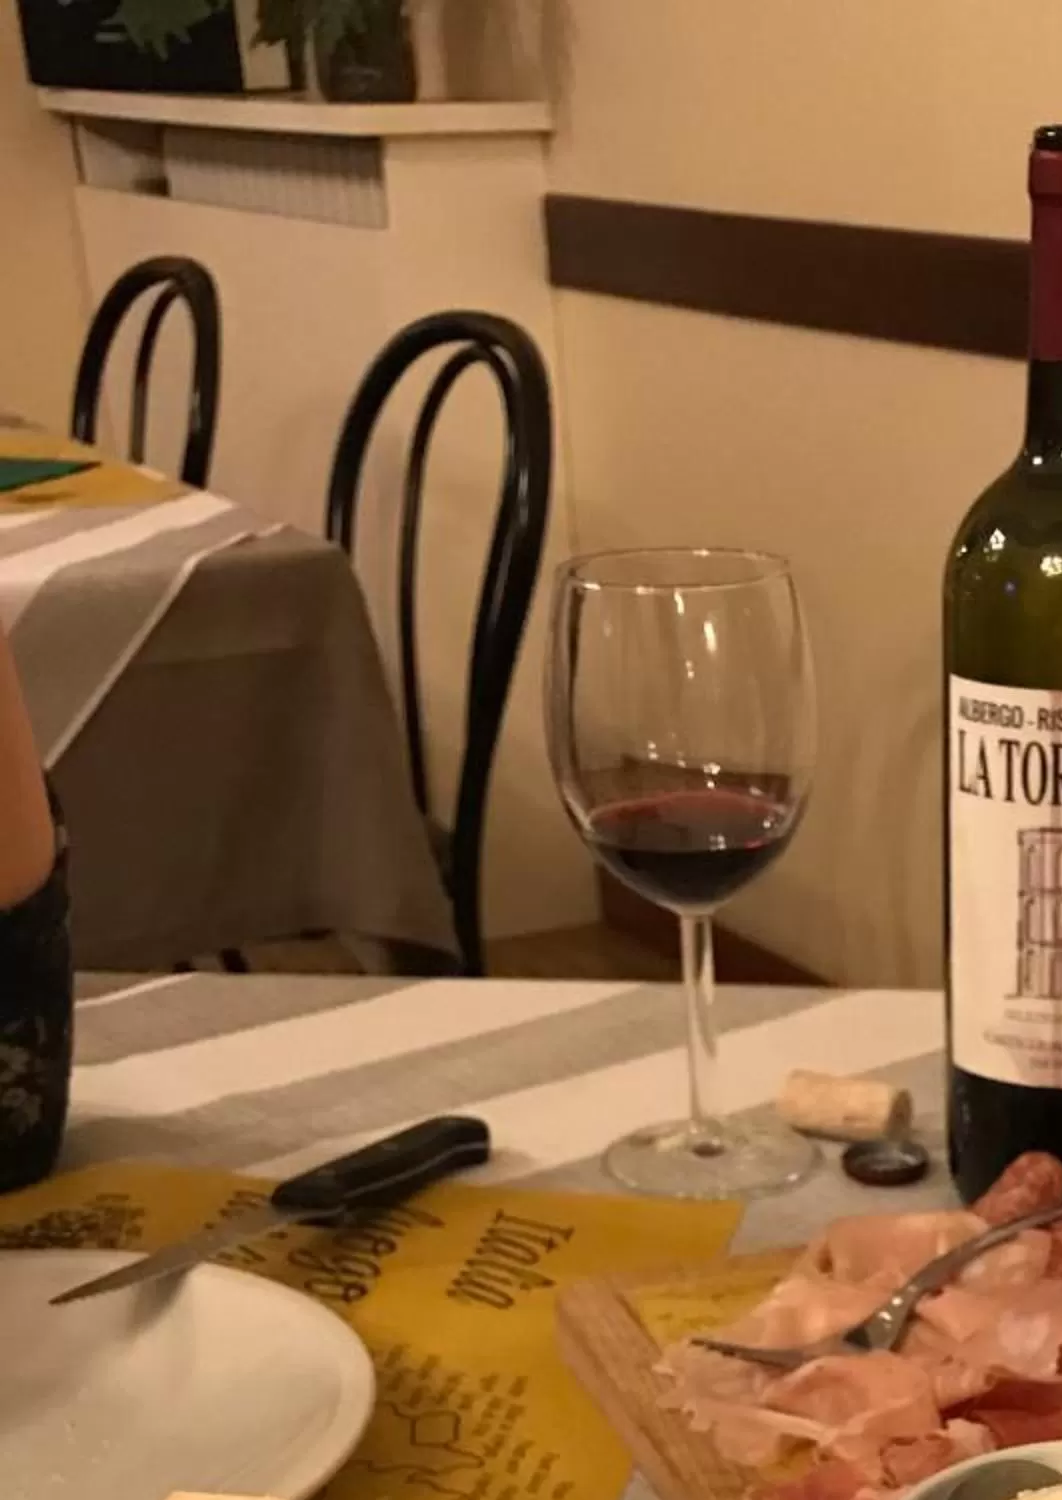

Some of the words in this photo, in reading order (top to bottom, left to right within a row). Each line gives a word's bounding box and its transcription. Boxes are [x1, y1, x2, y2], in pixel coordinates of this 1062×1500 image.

[959, 696, 1024, 729] ALBERGO
[957, 728, 993, 799] LA
[445, 1208, 574, 1310] Italia
